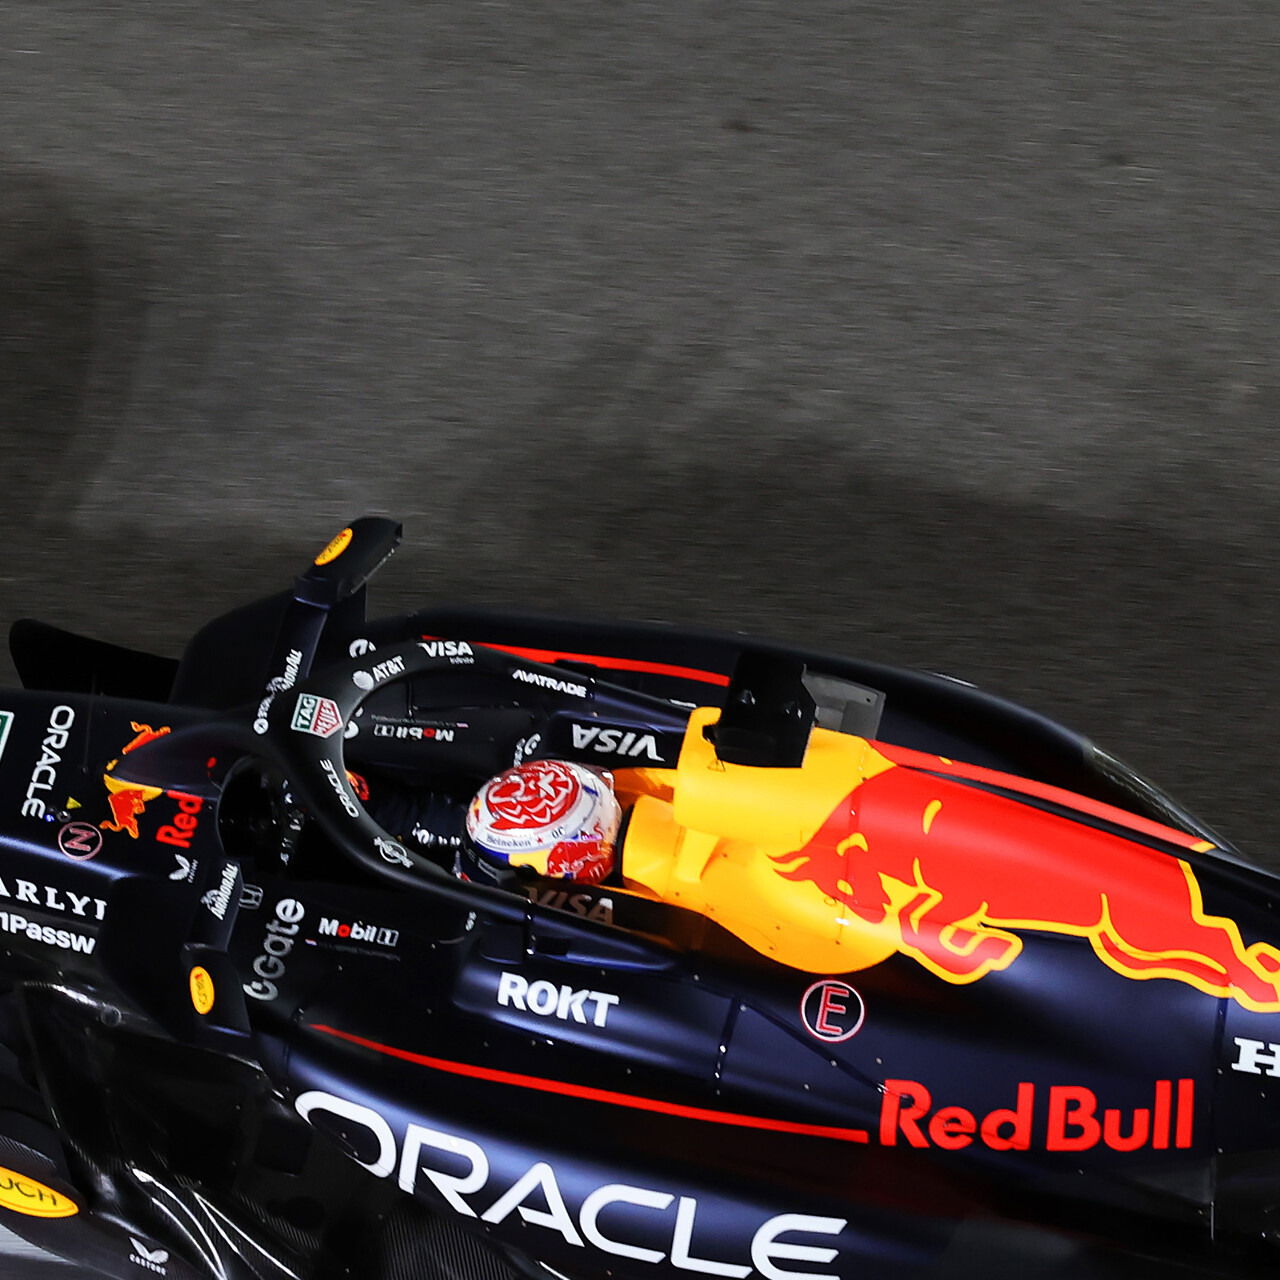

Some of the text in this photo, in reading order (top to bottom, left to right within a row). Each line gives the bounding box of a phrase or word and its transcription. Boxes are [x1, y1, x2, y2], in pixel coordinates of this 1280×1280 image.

[416, 640, 473, 657] VISA
[373, 656, 406, 682] AT&T
[296, 697, 316, 730] TAG
[396, 726, 455, 742] Mobil
[572, 723, 665, 762] VISA
[21, 705, 75, 819] ORACLE
[156, 790, 205, 849] Red
[318, 916, 377, 944] Mobil
[497, 971, 620, 1028] ROKT
[879, 1078, 1195, 1152] Red Bull
